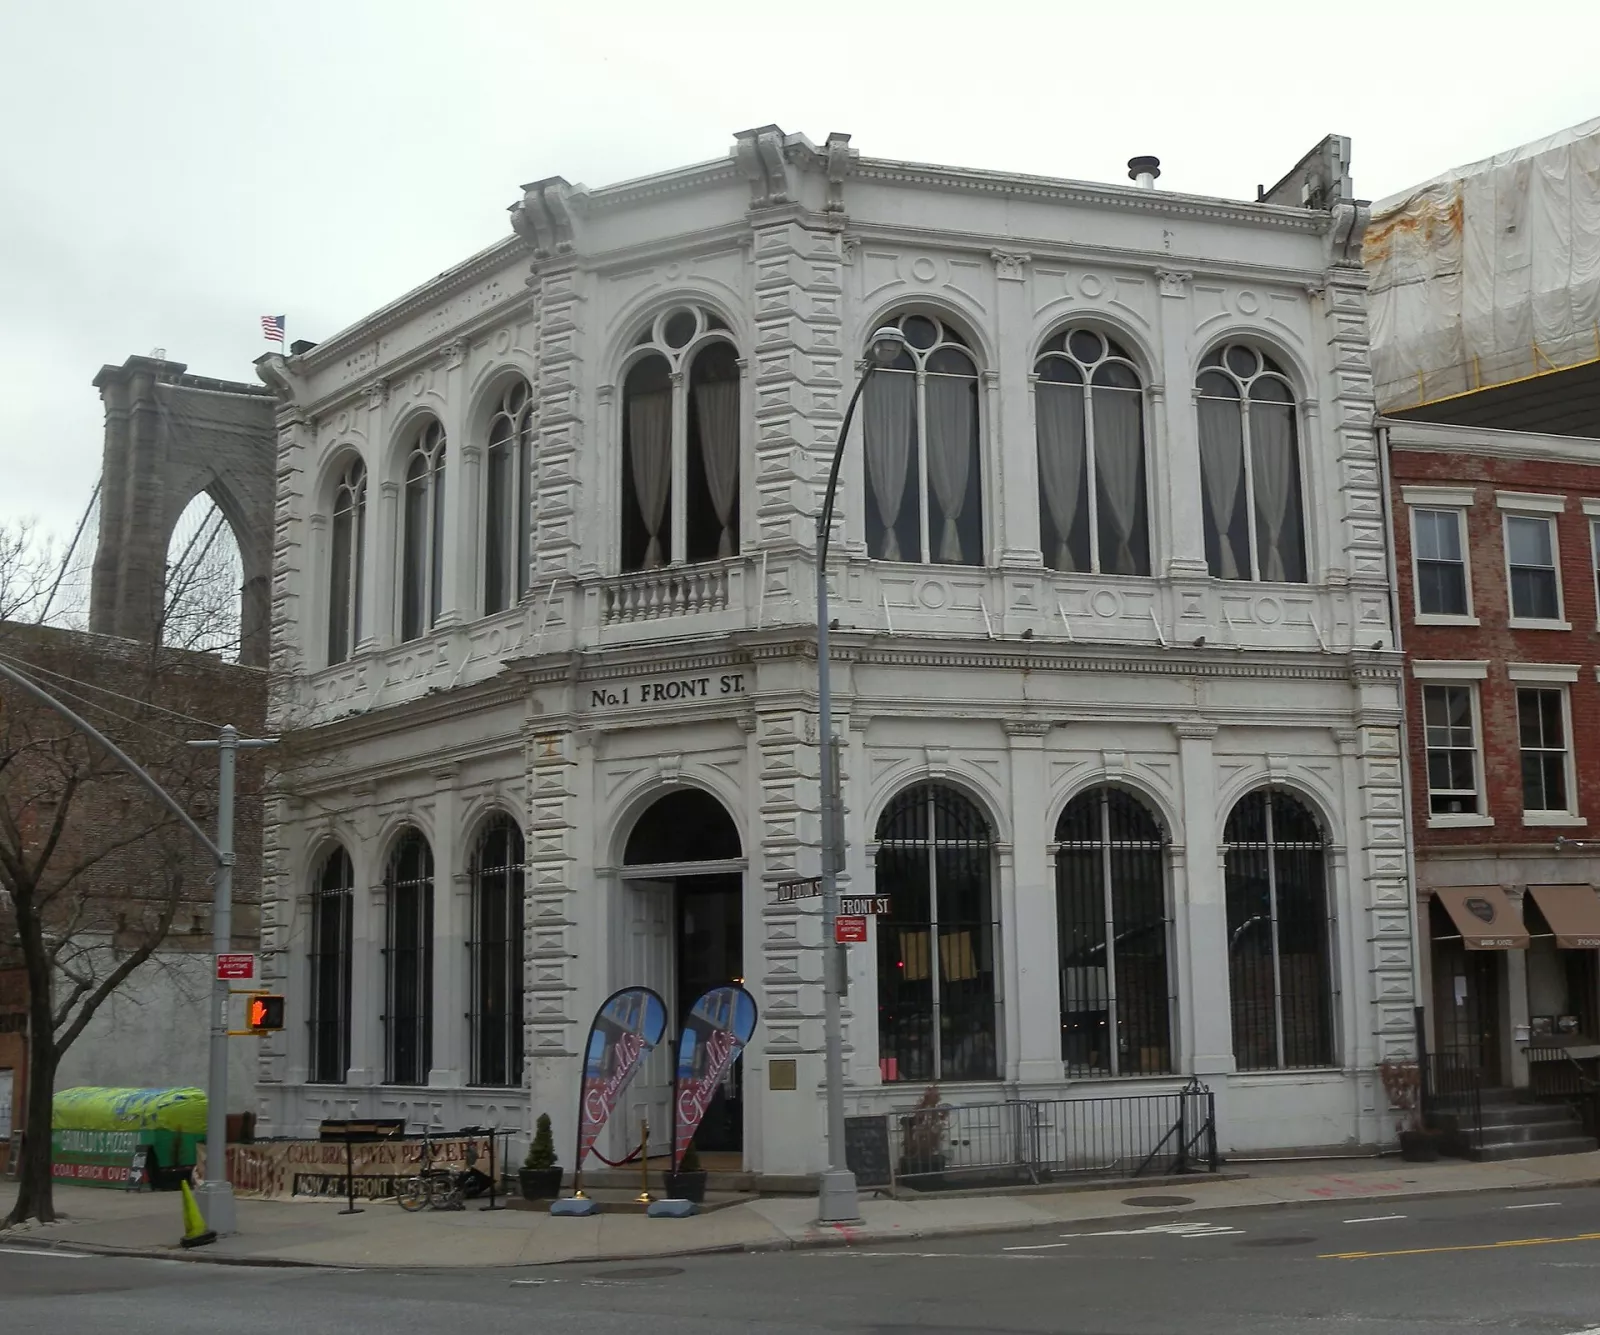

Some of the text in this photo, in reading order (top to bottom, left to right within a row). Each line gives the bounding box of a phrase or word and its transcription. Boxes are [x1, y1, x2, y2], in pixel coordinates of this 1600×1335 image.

[640, 678, 710, 702] FRONT
[720, 674, 745, 693] ST.
[841, 898, 889, 914] FRONT ST
[286, 1144, 318, 1165] COAL
[53, 1163, 75, 1177] COAL
[77, 1165, 102, 1179] BRICK
[297, 1175, 324, 1194] NOW
[326, 1177, 340, 1195] AT
[352, 1177, 389, 1197] FRONT
